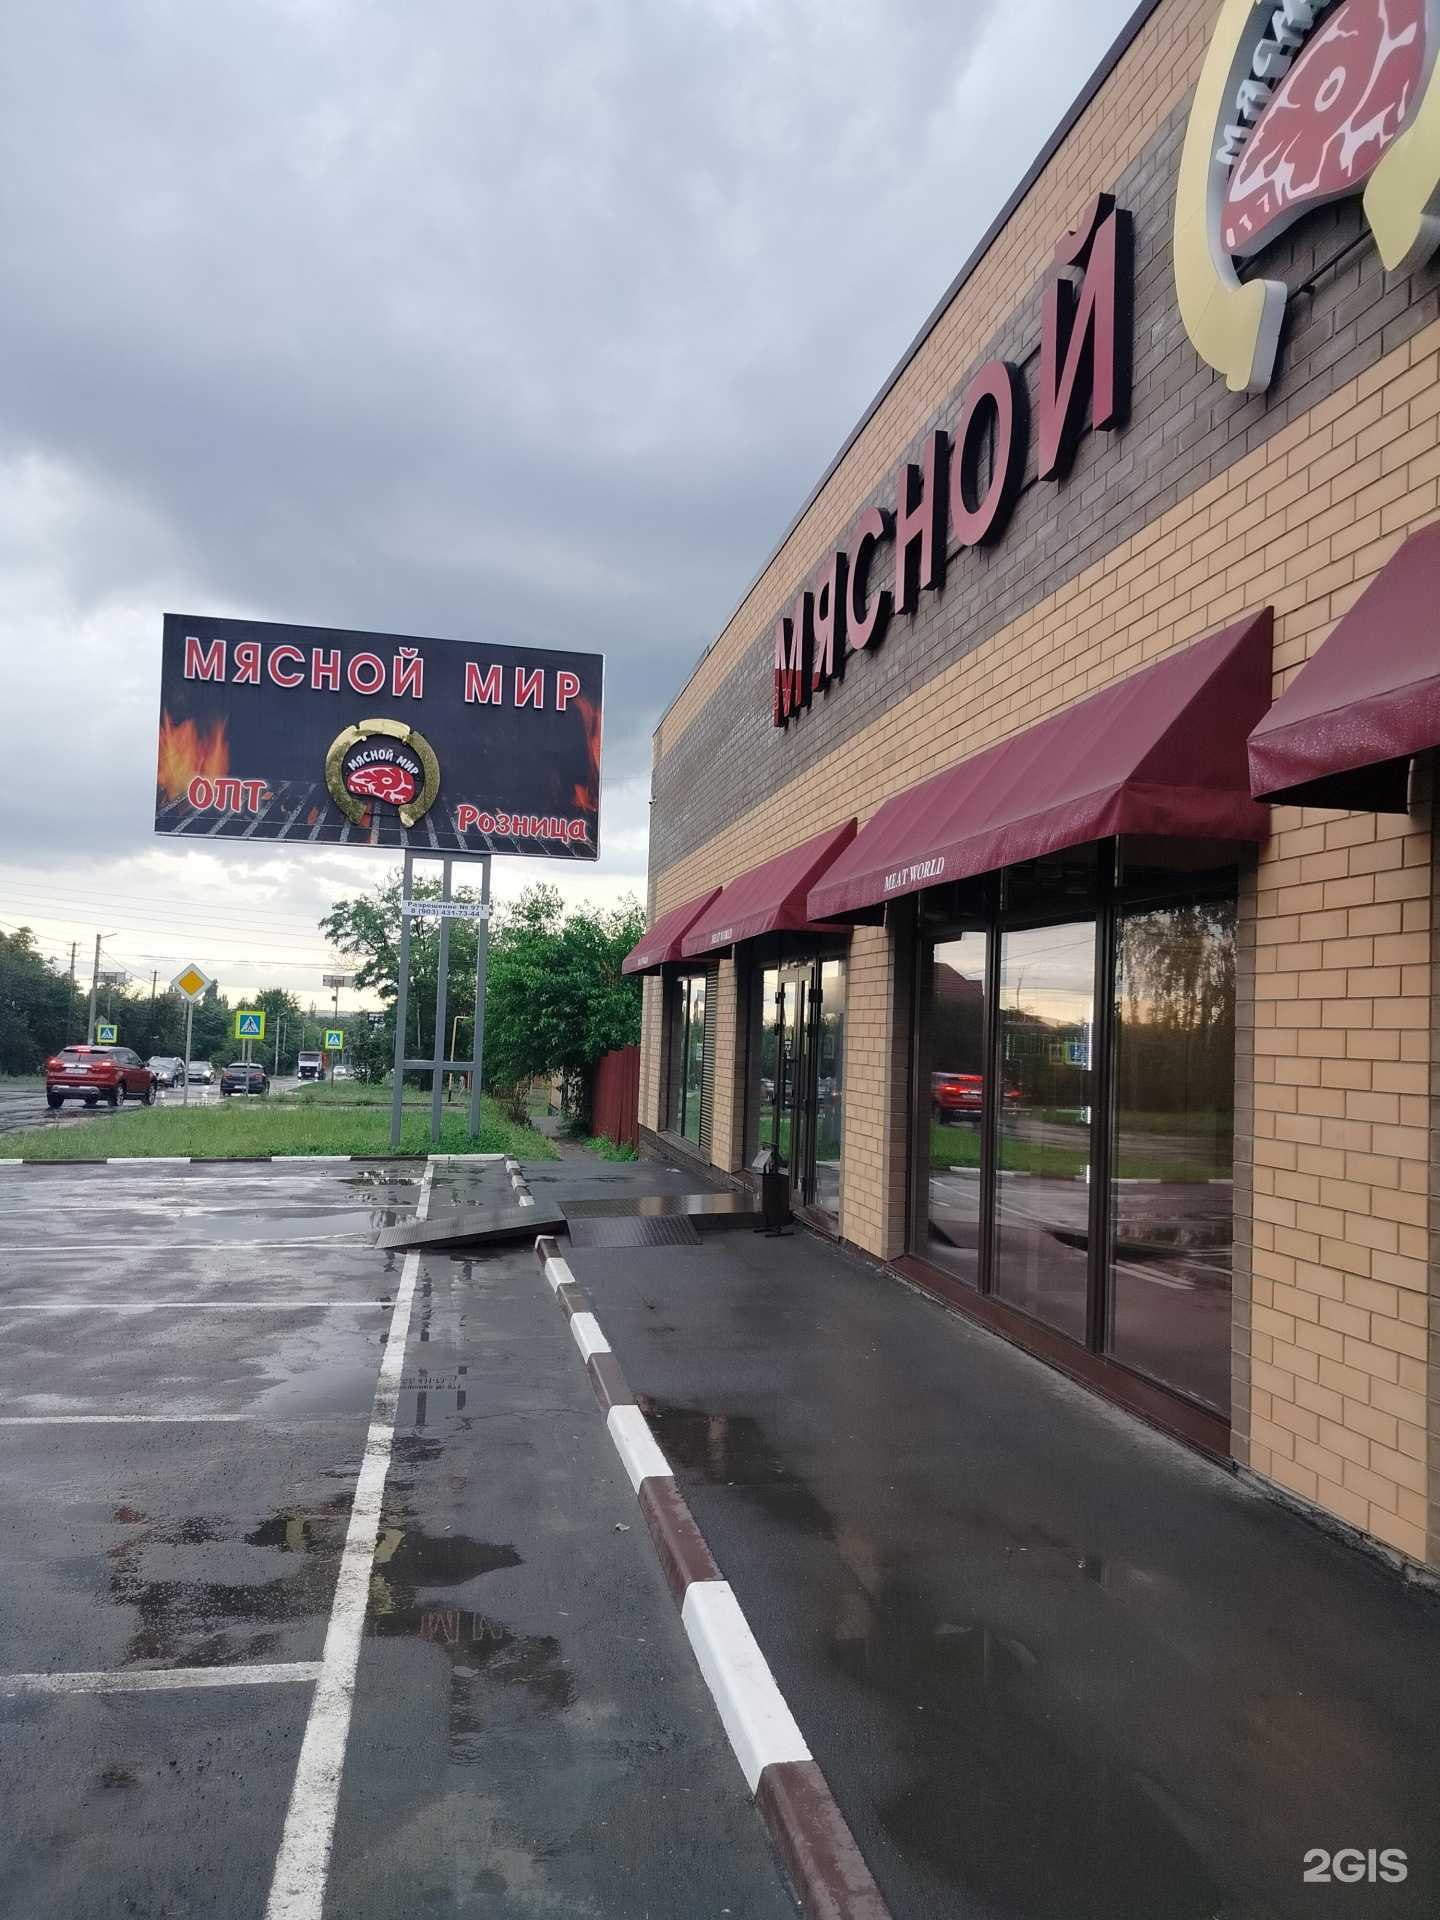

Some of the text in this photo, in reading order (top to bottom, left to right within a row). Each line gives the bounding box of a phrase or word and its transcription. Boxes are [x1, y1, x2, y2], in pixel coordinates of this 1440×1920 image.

[773, 192, 1132, 728] МЯСНОЙ
[184, 636, 581, 711] МЯСНОЙ МИР
[348, 749, 419, 774] МЯСНОЙ МИР
[188, 776, 267, 813] ОПТ
[457, 804, 587, 844] Розница
[884, 856, 945, 892] MEAT WORLD
